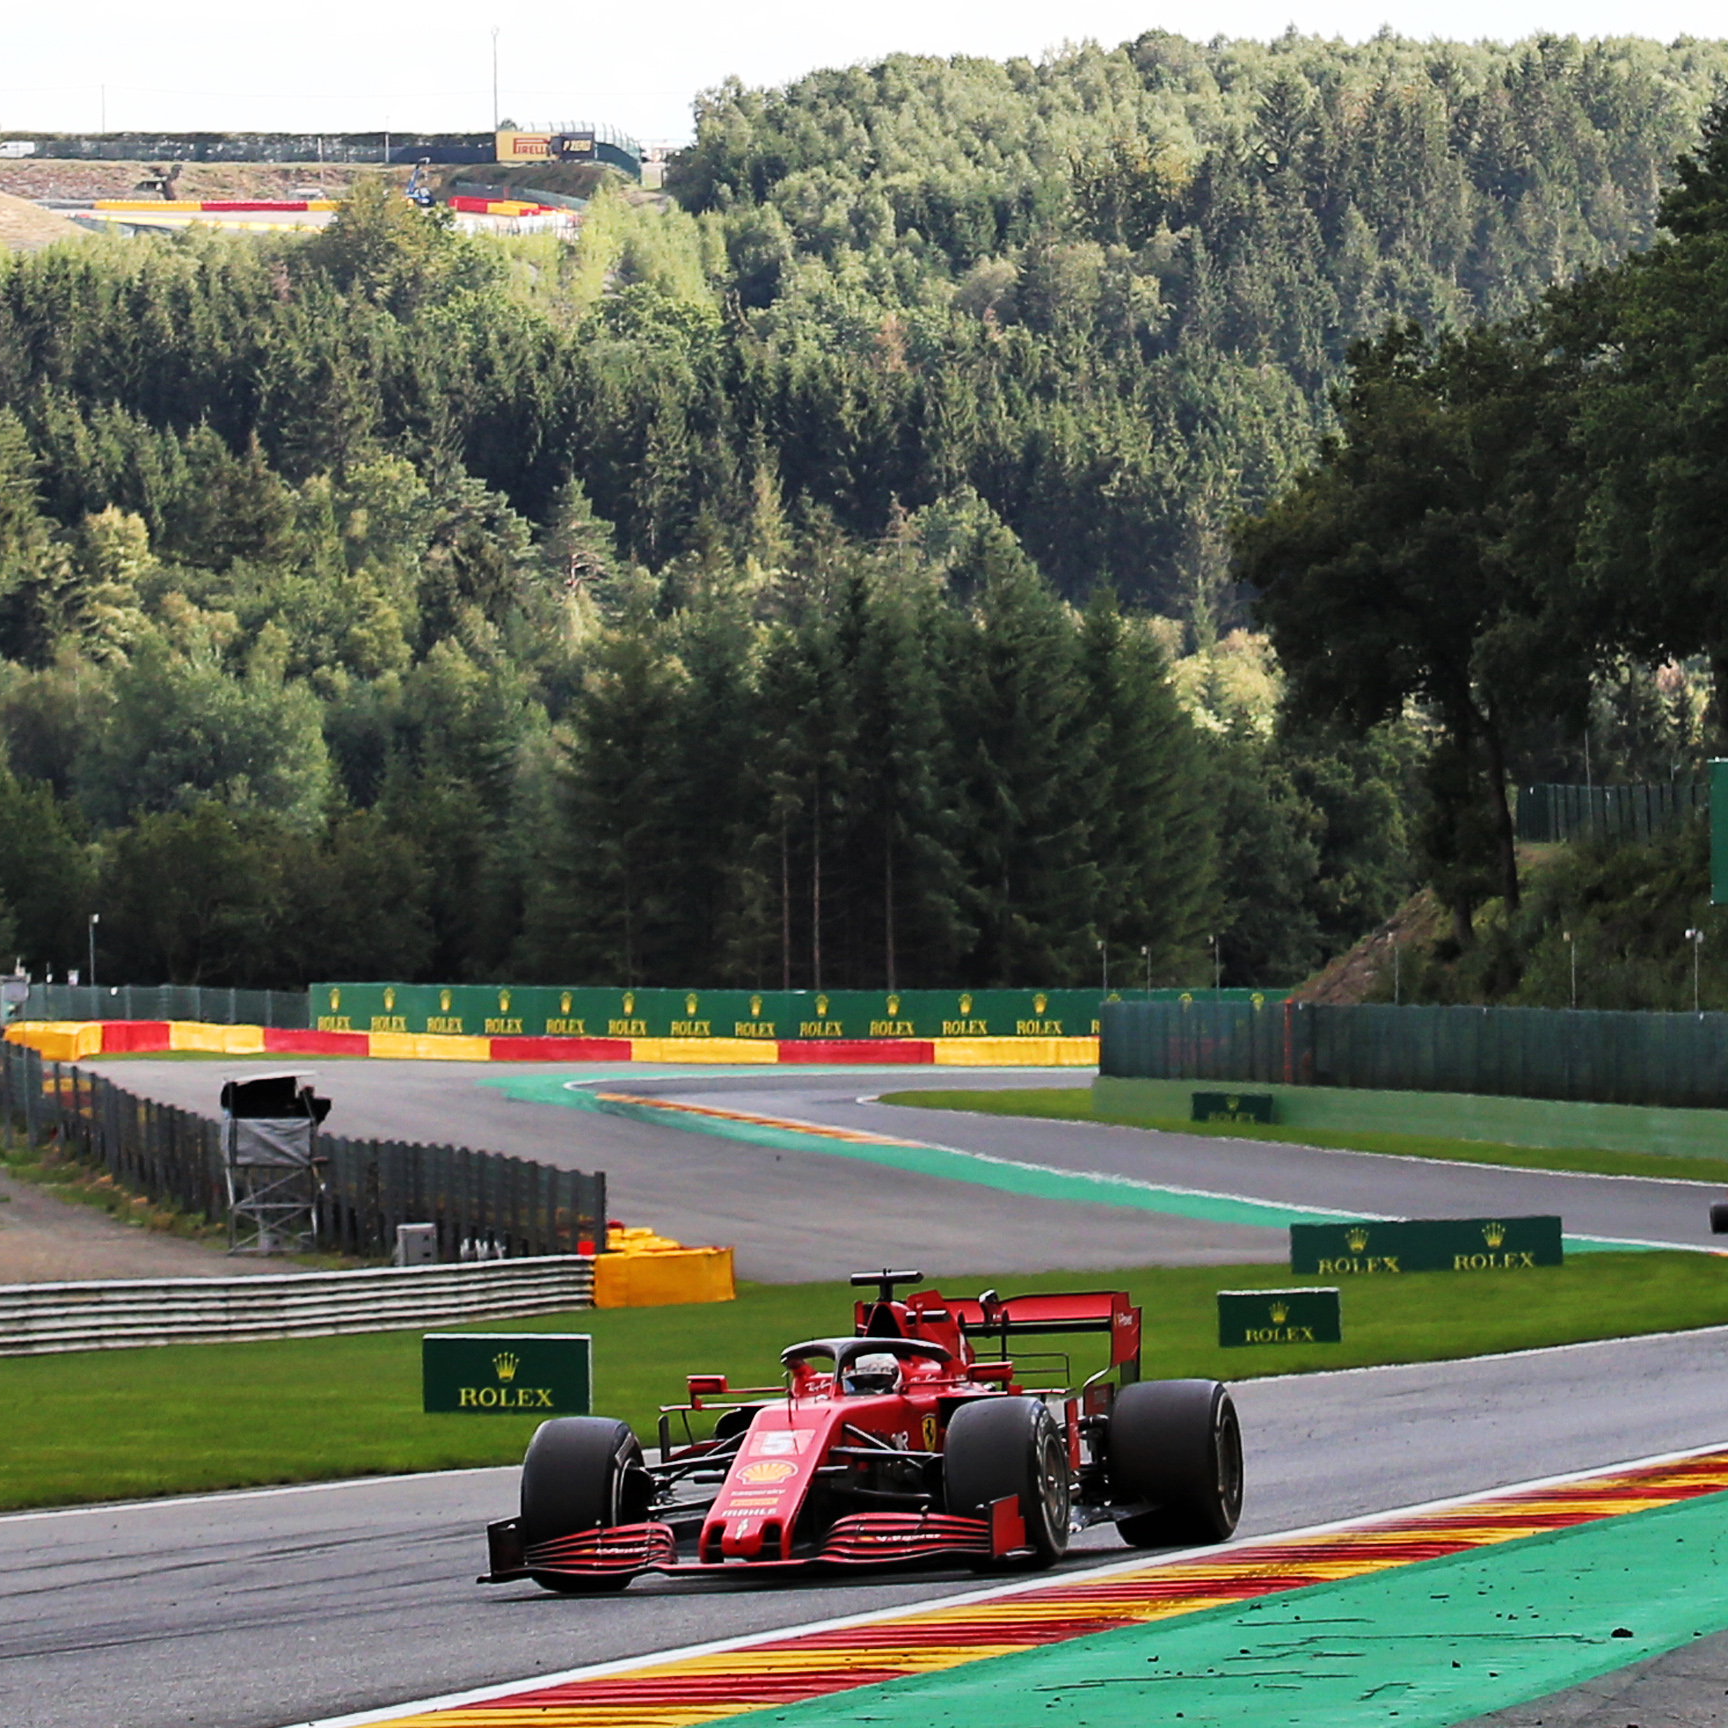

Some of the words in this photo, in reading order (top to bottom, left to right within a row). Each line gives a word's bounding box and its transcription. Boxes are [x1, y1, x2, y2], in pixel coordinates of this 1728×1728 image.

[317, 1015, 351, 1031] ROLEX
[371, 1015, 407, 1033] ROLEX
[426, 1016, 463, 1034] ROLEX
[484, 1017, 523, 1035] ROLEX
[545, 1018, 585, 1035] ROLEX
[608, 1019, 648, 1036] ROLEX
[670, 1020, 711, 1037] ROLEX
[734, 1021, 775, 1037] ROLEX
[799, 1021, 843, 1037] ROLEX
[869, 1020, 915, 1037] ROLEX
[941, 1019, 988, 1036] ROLEX
[1015, 1019, 1063, 1036] ROLEX
[1317, 1255, 1400, 1275] ROLEX
[1453, 1252, 1535, 1271] ROLEX
[1245, 1327, 1314, 1342] ROLEX
[458, 1386, 554, 1408] ROLEX
[760, 1431, 795, 1454] 5
